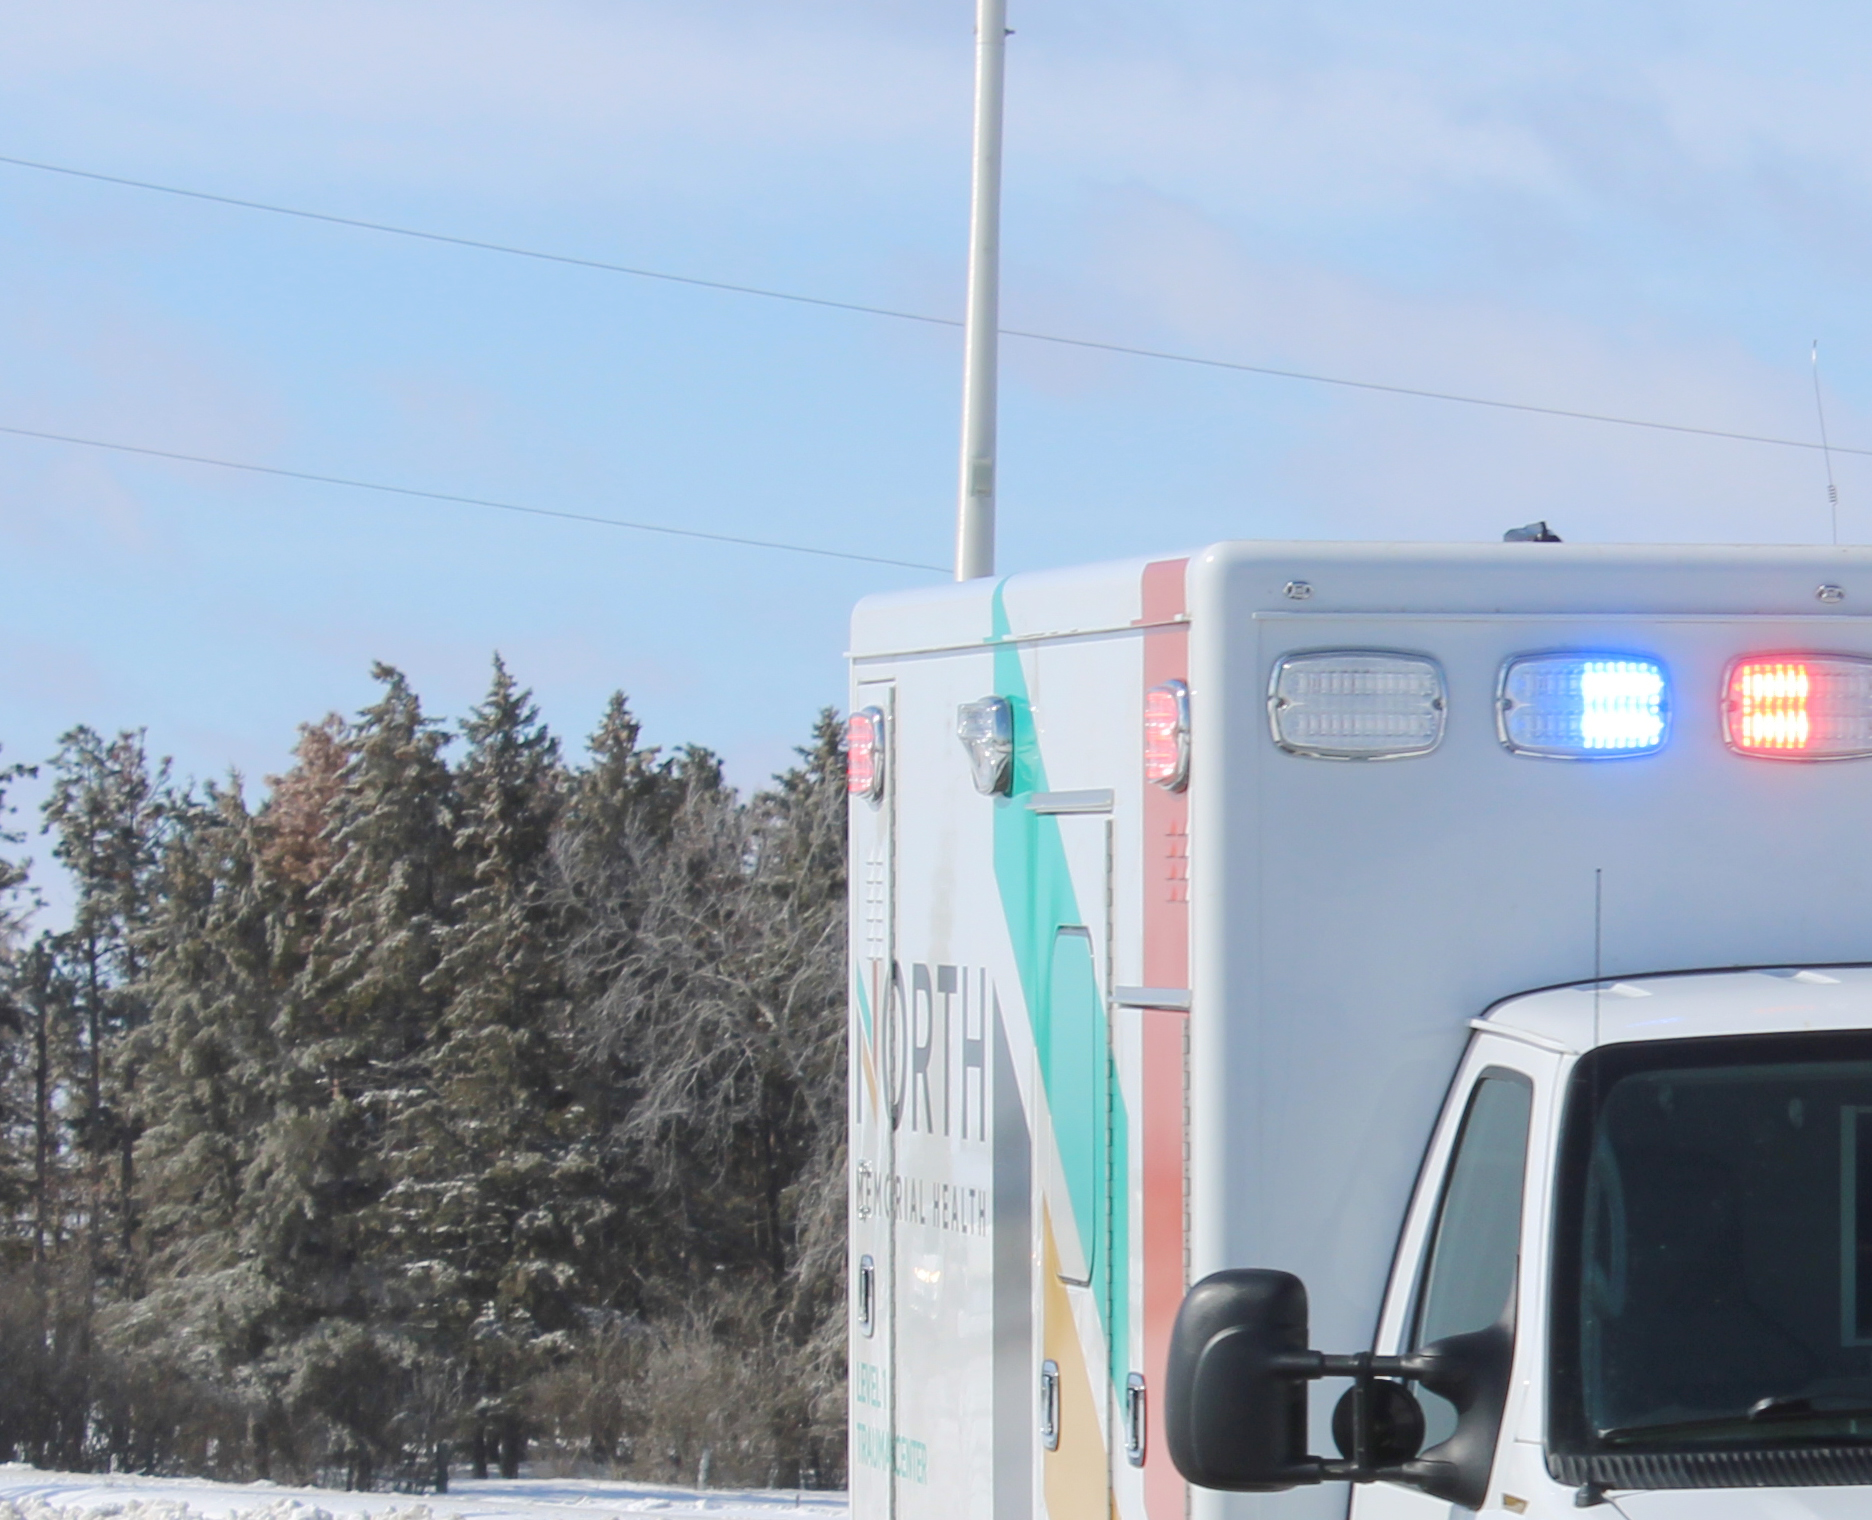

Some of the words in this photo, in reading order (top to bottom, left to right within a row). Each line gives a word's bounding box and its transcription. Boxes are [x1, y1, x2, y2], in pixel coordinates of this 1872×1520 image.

[856, 955, 986, 1142] NORTH
[857, 1168, 926, 1225] MEMORIAL
[933, 1181, 987, 1238] HEALTH
[857, 1361, 881, 1409] LEVEL
